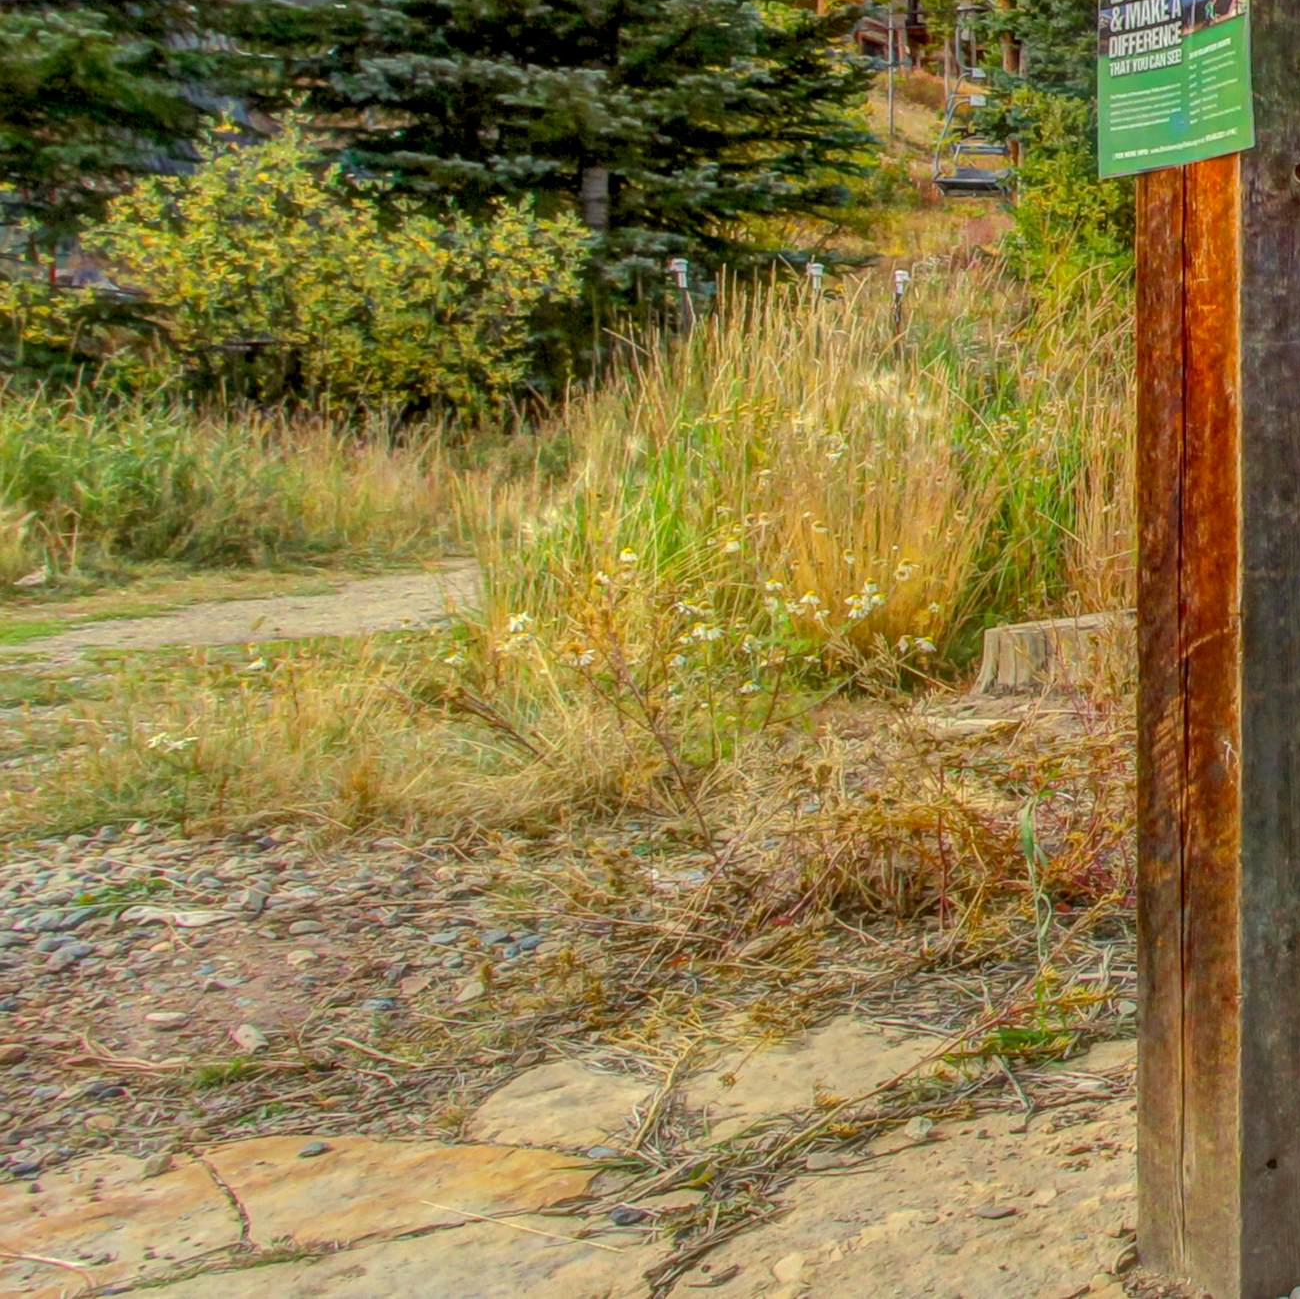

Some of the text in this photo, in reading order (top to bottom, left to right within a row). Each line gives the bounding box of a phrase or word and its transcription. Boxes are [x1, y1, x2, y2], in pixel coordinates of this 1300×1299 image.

[1110, 6, 1124, 33] &
[1109, 21, 1182, 59] DIFFERENCE
[1110, 60, 1131, 76] THAT
[1132, 56, 1149, 73] YOU
[1149, 52, 1167, 69] CAN
